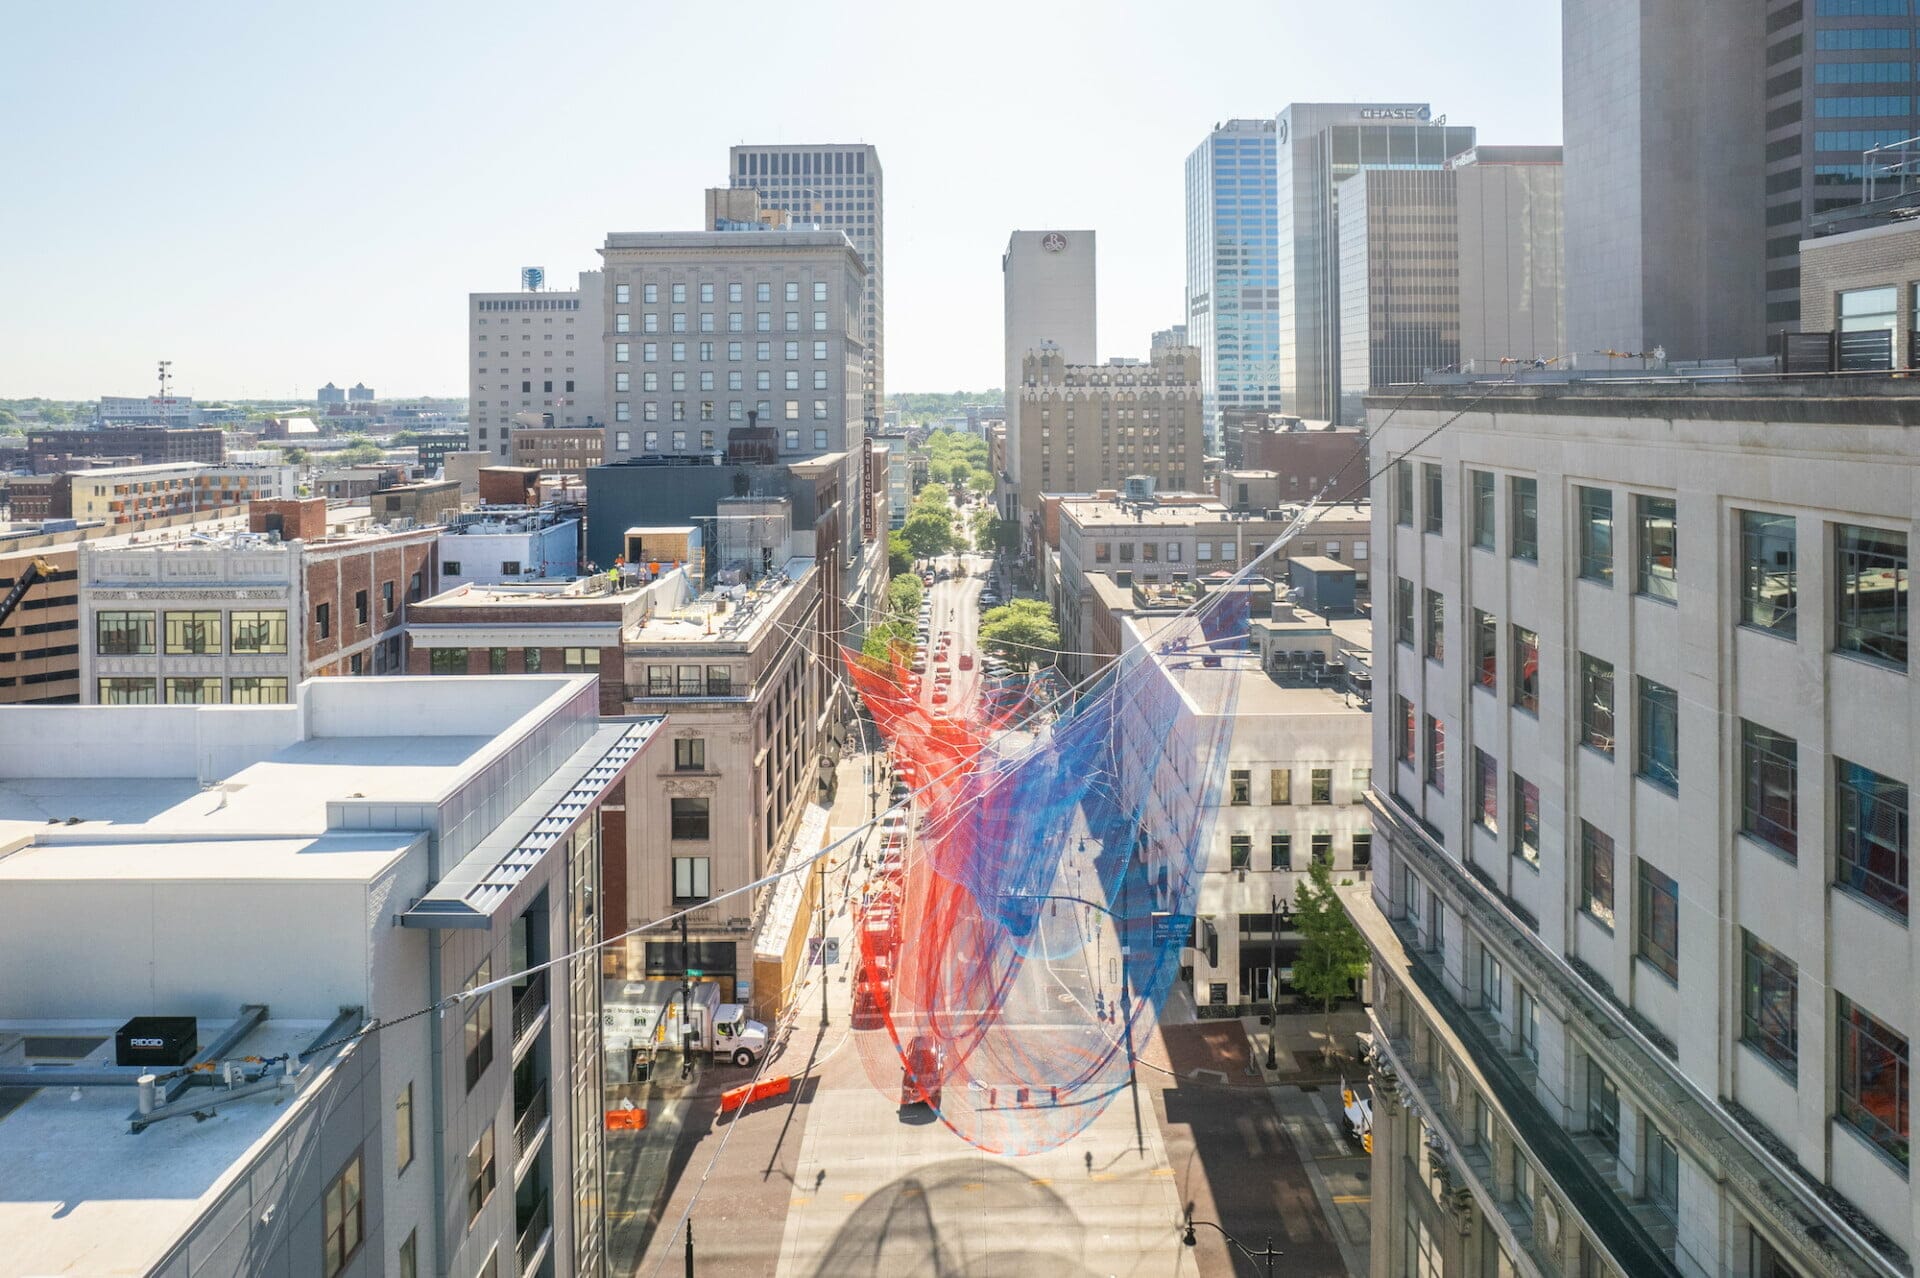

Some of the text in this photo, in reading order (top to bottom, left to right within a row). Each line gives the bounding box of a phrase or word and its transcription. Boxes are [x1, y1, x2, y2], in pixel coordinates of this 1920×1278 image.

[1361, 108, 1416, 119] CHASE
[864, 443, 873, 529] Residence Inn
[130, 1038, 164, 1047] RIDGID
